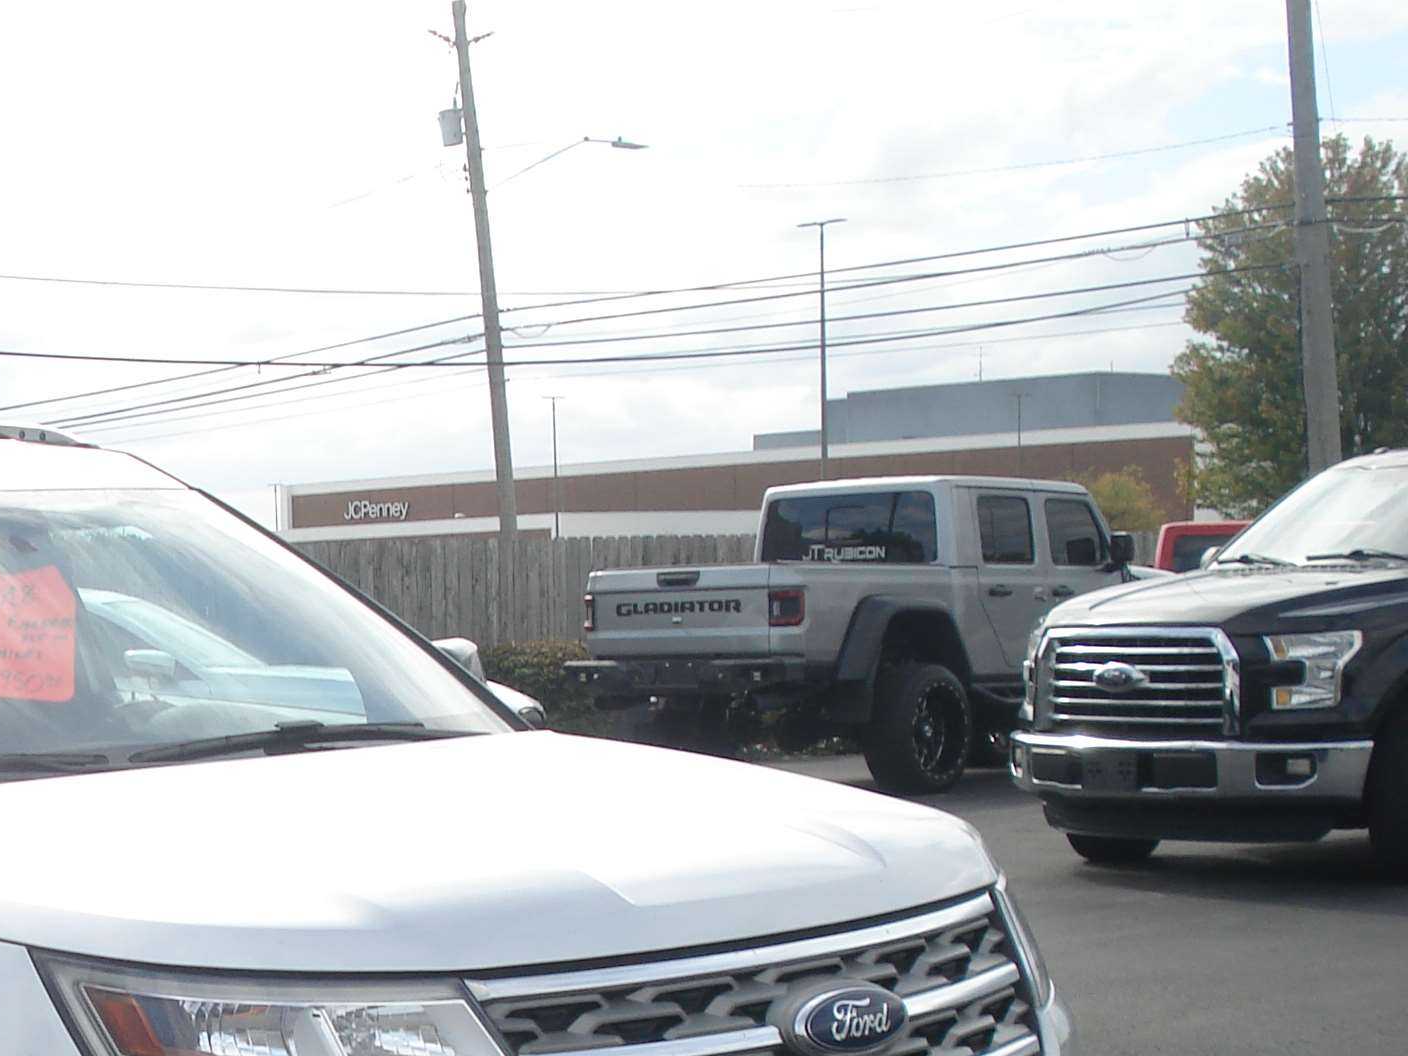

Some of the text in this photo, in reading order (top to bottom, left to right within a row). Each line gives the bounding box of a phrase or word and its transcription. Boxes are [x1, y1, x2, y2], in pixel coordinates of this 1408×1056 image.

[344, 501, 408, 520] JCPenney
[824, 546, 886, 562] RUBICON
[616, 599, 741, 616] GLADIATOR
[831, 998, 890, 1041] Ford
